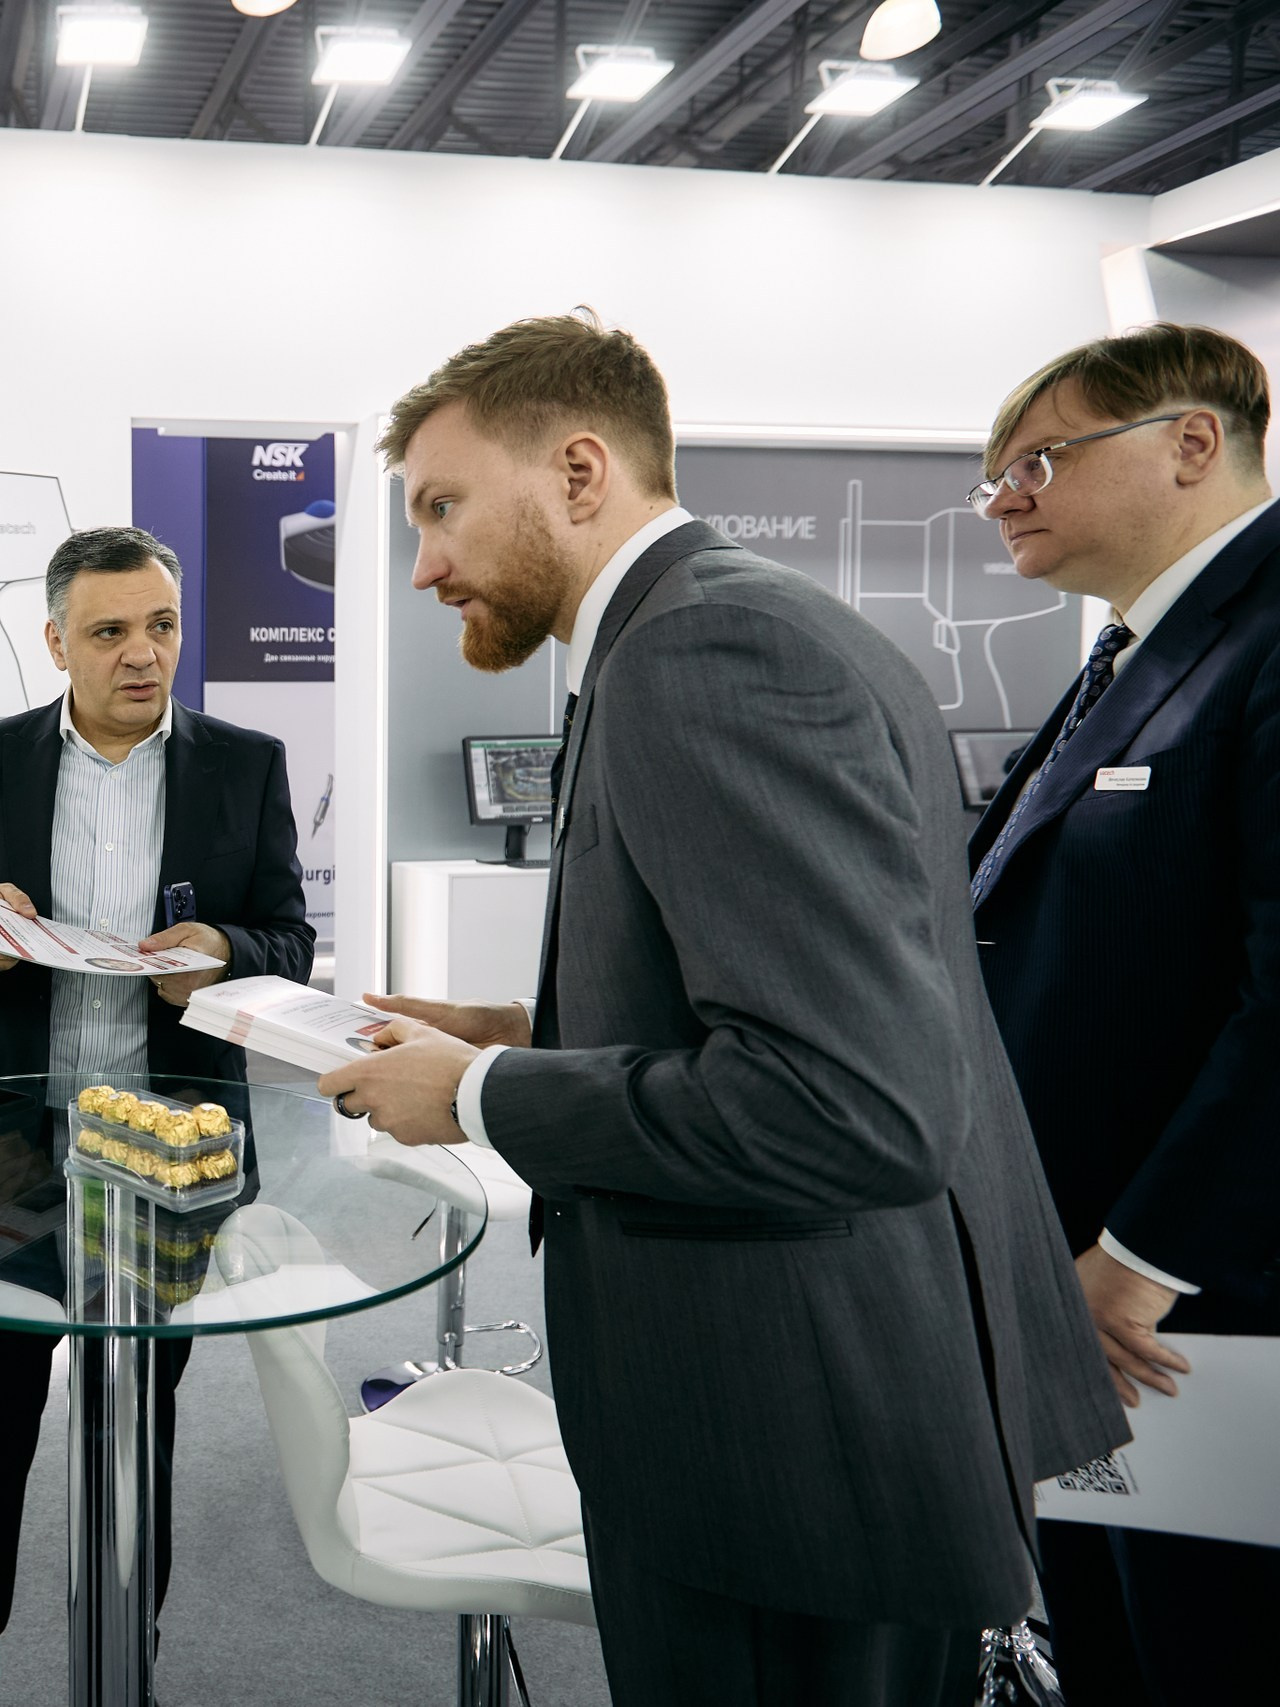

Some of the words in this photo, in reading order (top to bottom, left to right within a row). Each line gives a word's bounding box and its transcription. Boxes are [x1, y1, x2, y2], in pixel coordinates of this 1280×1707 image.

[251, 442, 309, 468] NSK
[252, 468, 289, 481] Create
[250, 627, 325, 642] КОМПЛЕКС
[264, 652, 279, 663] Две
[302, 864, 336, 885] urgi
